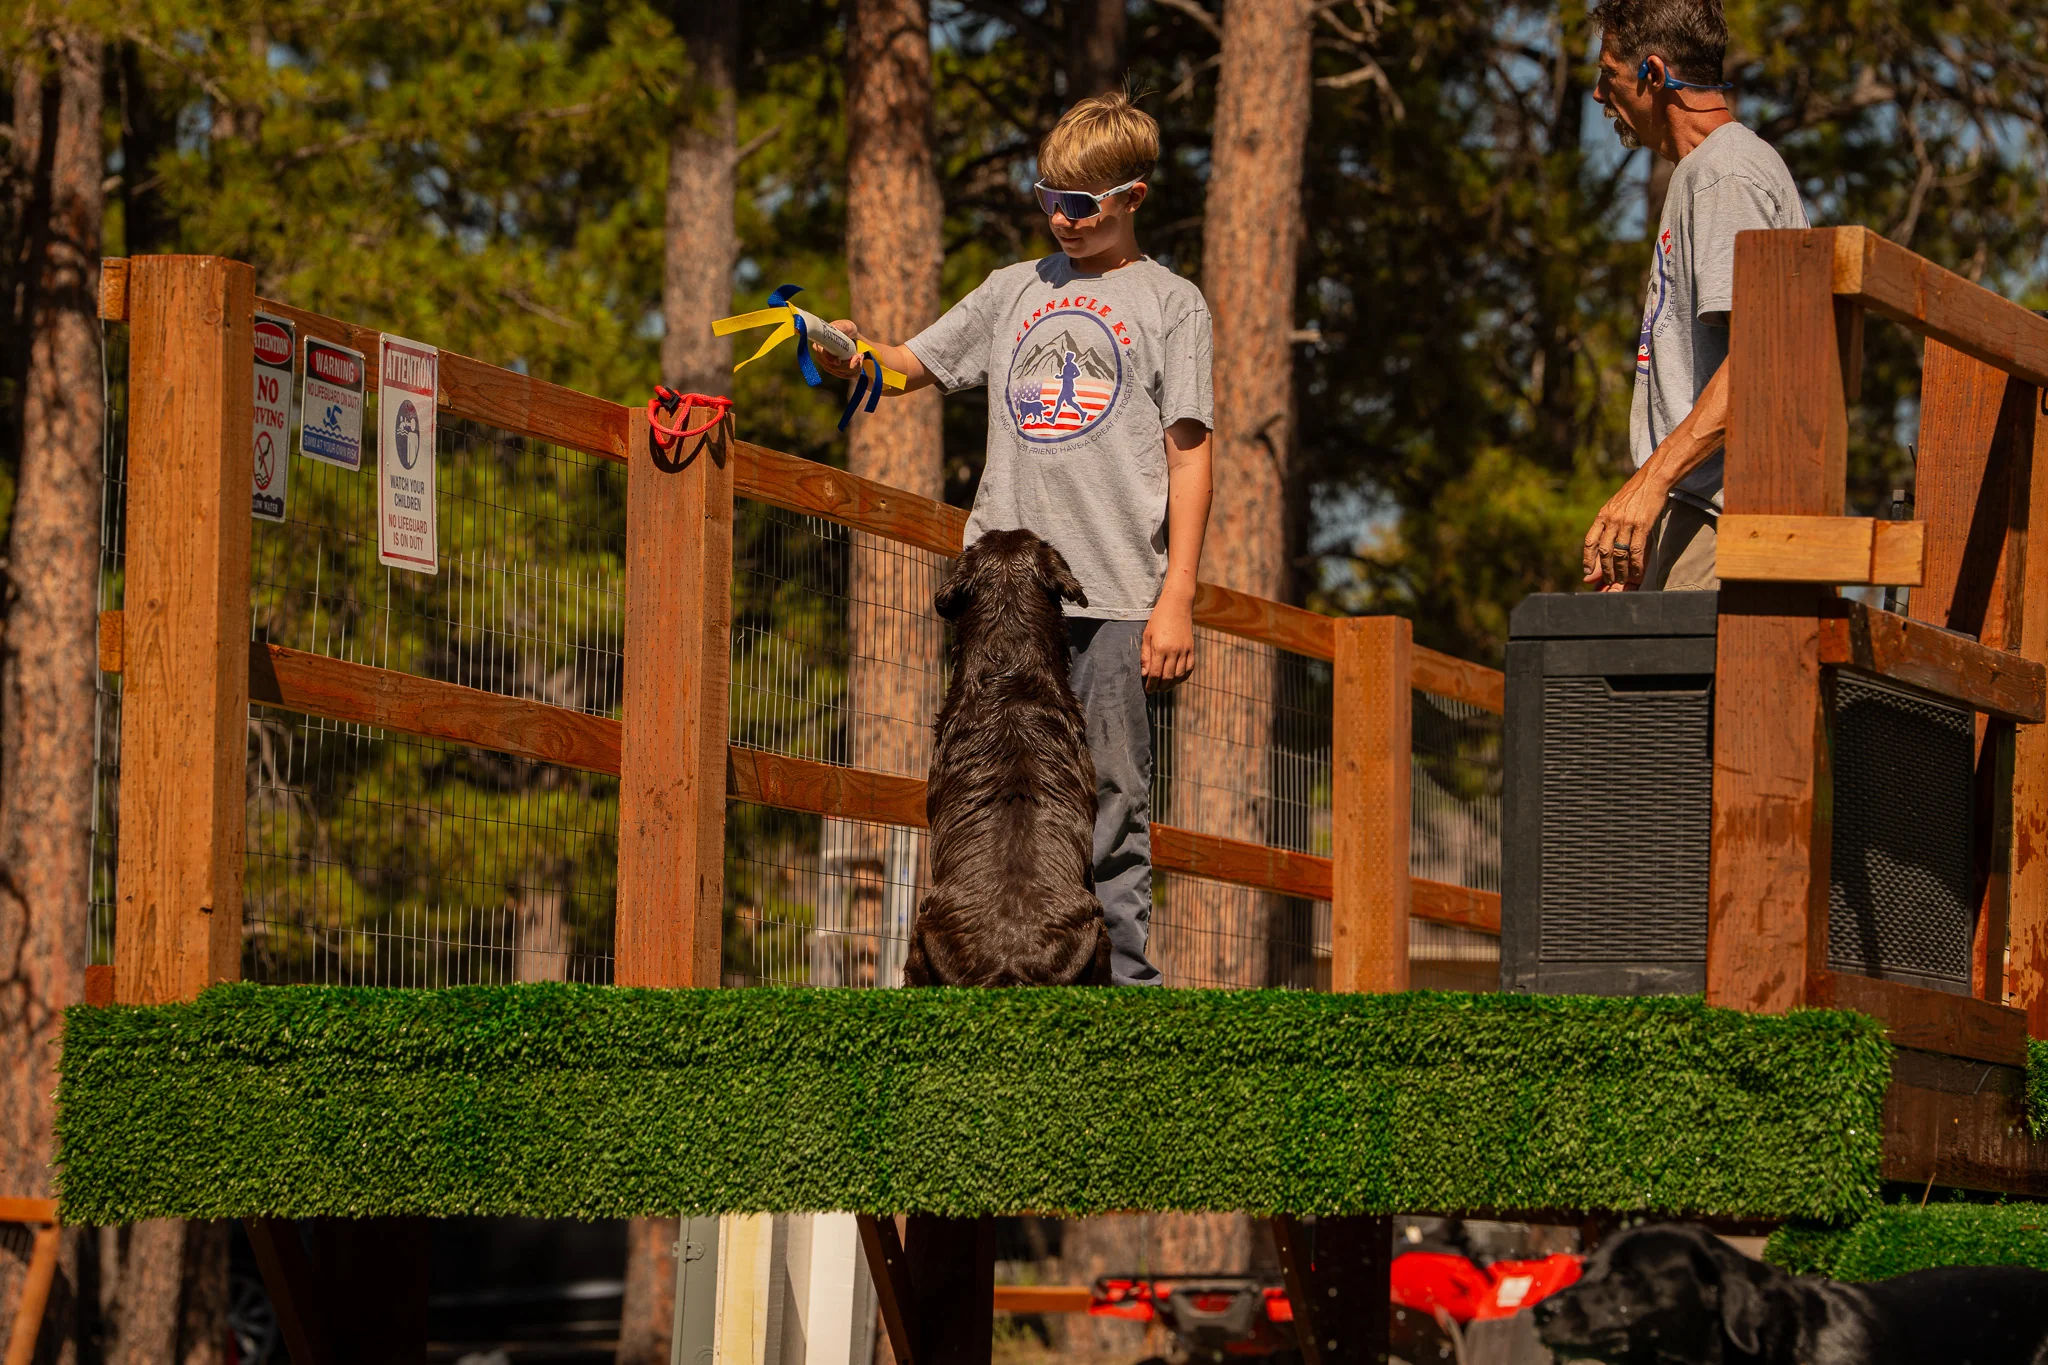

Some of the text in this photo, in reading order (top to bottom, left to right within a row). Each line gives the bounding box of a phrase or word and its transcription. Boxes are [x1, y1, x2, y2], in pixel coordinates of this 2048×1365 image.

[1655, 322, 1669, 338] LIFE
[315, 351, 354, 382] WARNING
[386, 349, 433, 391] ATTENTION
[257, 373, 279, 404] NO
[307, 382, 315, 397] NO
[1029, 447, 1058, 455] FRIEND
[1060, 442, 1083, 454] HAVE
[1090, 421, 1115, 442] GREAT
[1114, 409, 1123, 423] LIFE
[1119, 365, 1136, 409] TOGETHER
[390, 474, 425, 495] WATCH YOUR
[394, 493, 422, 512] CHILDREN
[388, 513, 428, 535] NO LIFEGUARD
[393, 532, 424, 551] IS ON DUTY
